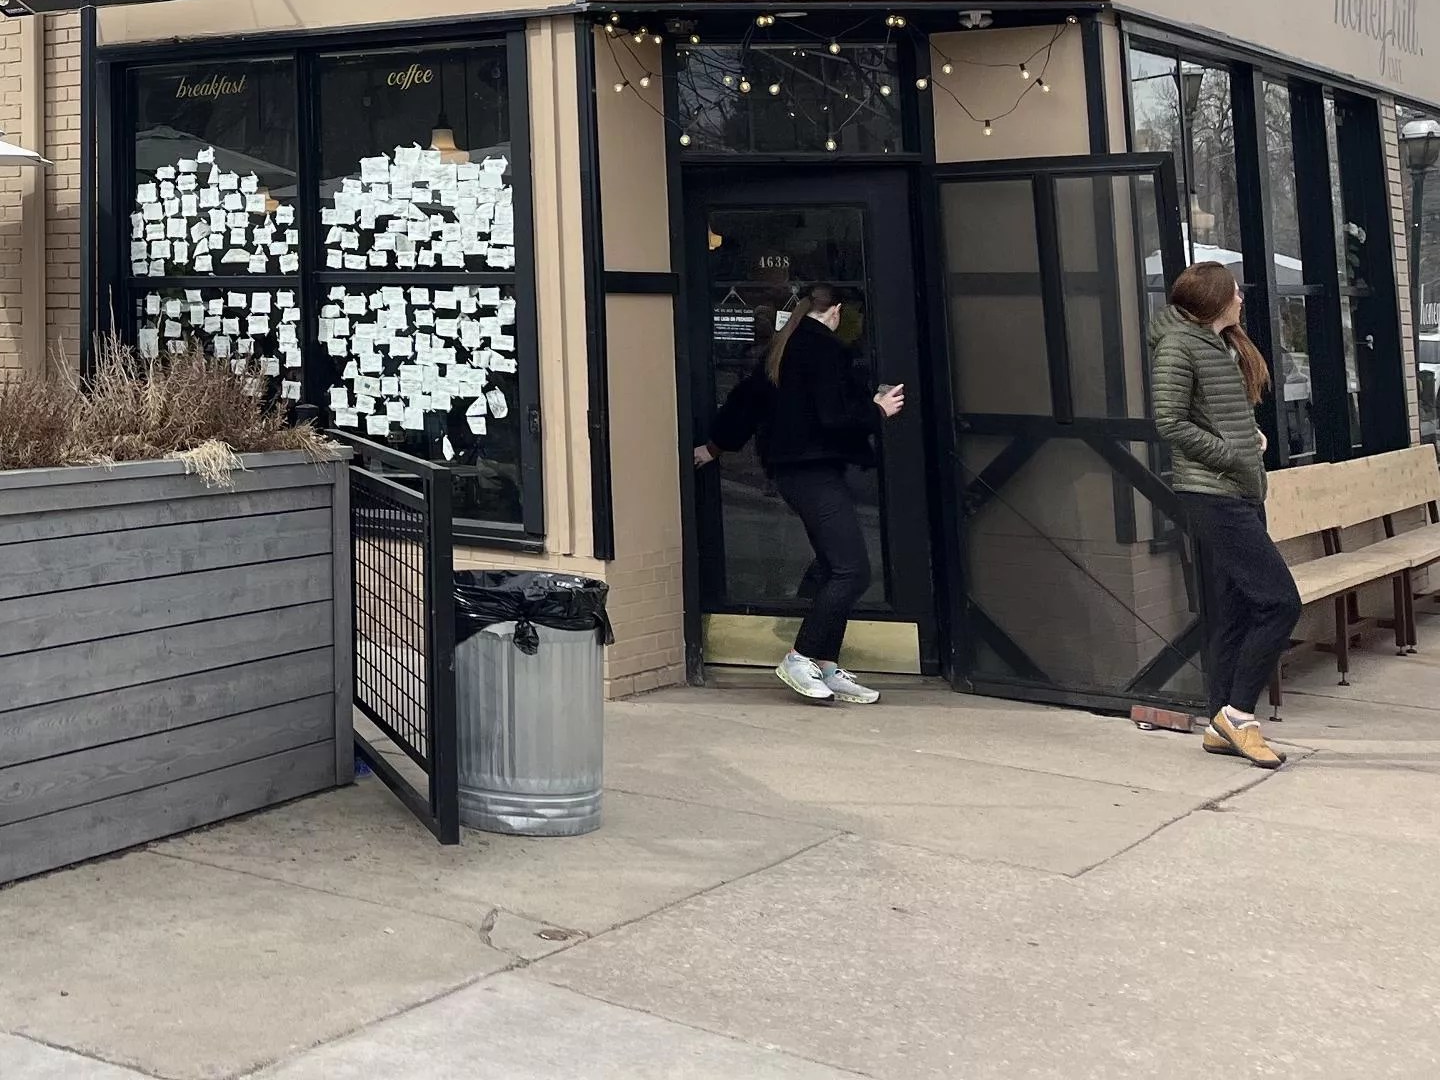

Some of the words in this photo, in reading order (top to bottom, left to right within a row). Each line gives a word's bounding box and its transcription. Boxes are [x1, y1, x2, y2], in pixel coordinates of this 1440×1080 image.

[175, 74, 246, 100] breakfast
[387, 63, 434, 90] coffee
[759, 255, 790, 269] 4638
